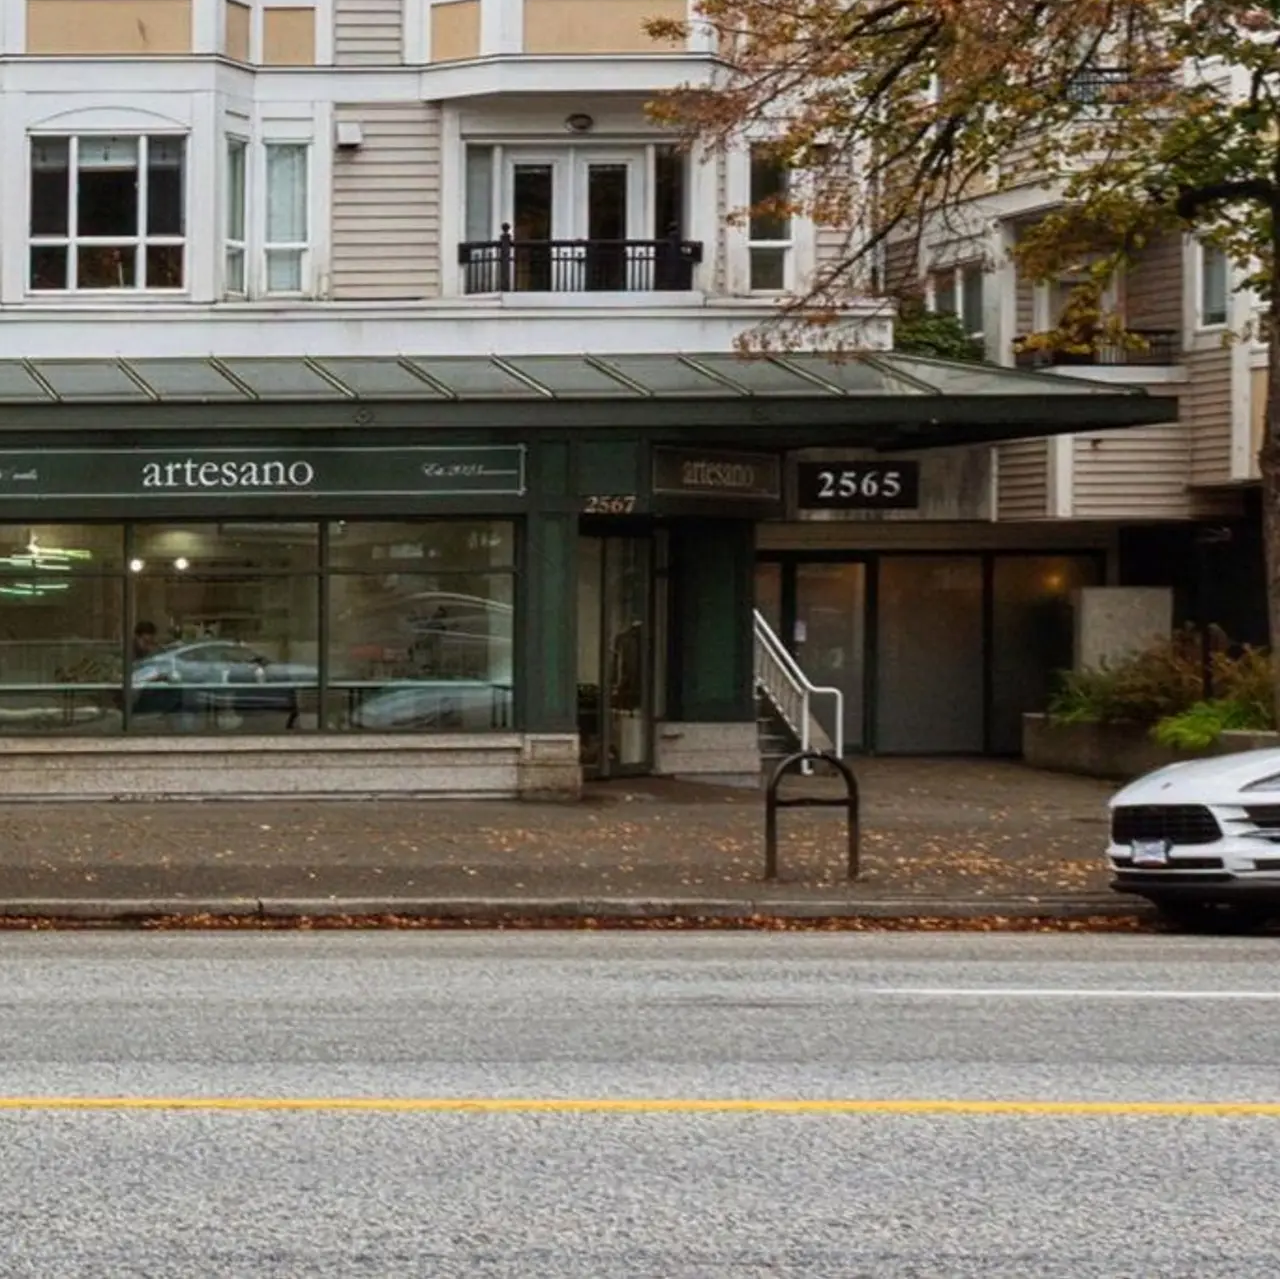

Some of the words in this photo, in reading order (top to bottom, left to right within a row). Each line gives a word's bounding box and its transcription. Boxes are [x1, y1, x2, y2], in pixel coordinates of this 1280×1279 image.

[142, 457, 314, 487] artesano
[816, 470, 902, 498] 2565
[583, 495, 637, 513] 2567
